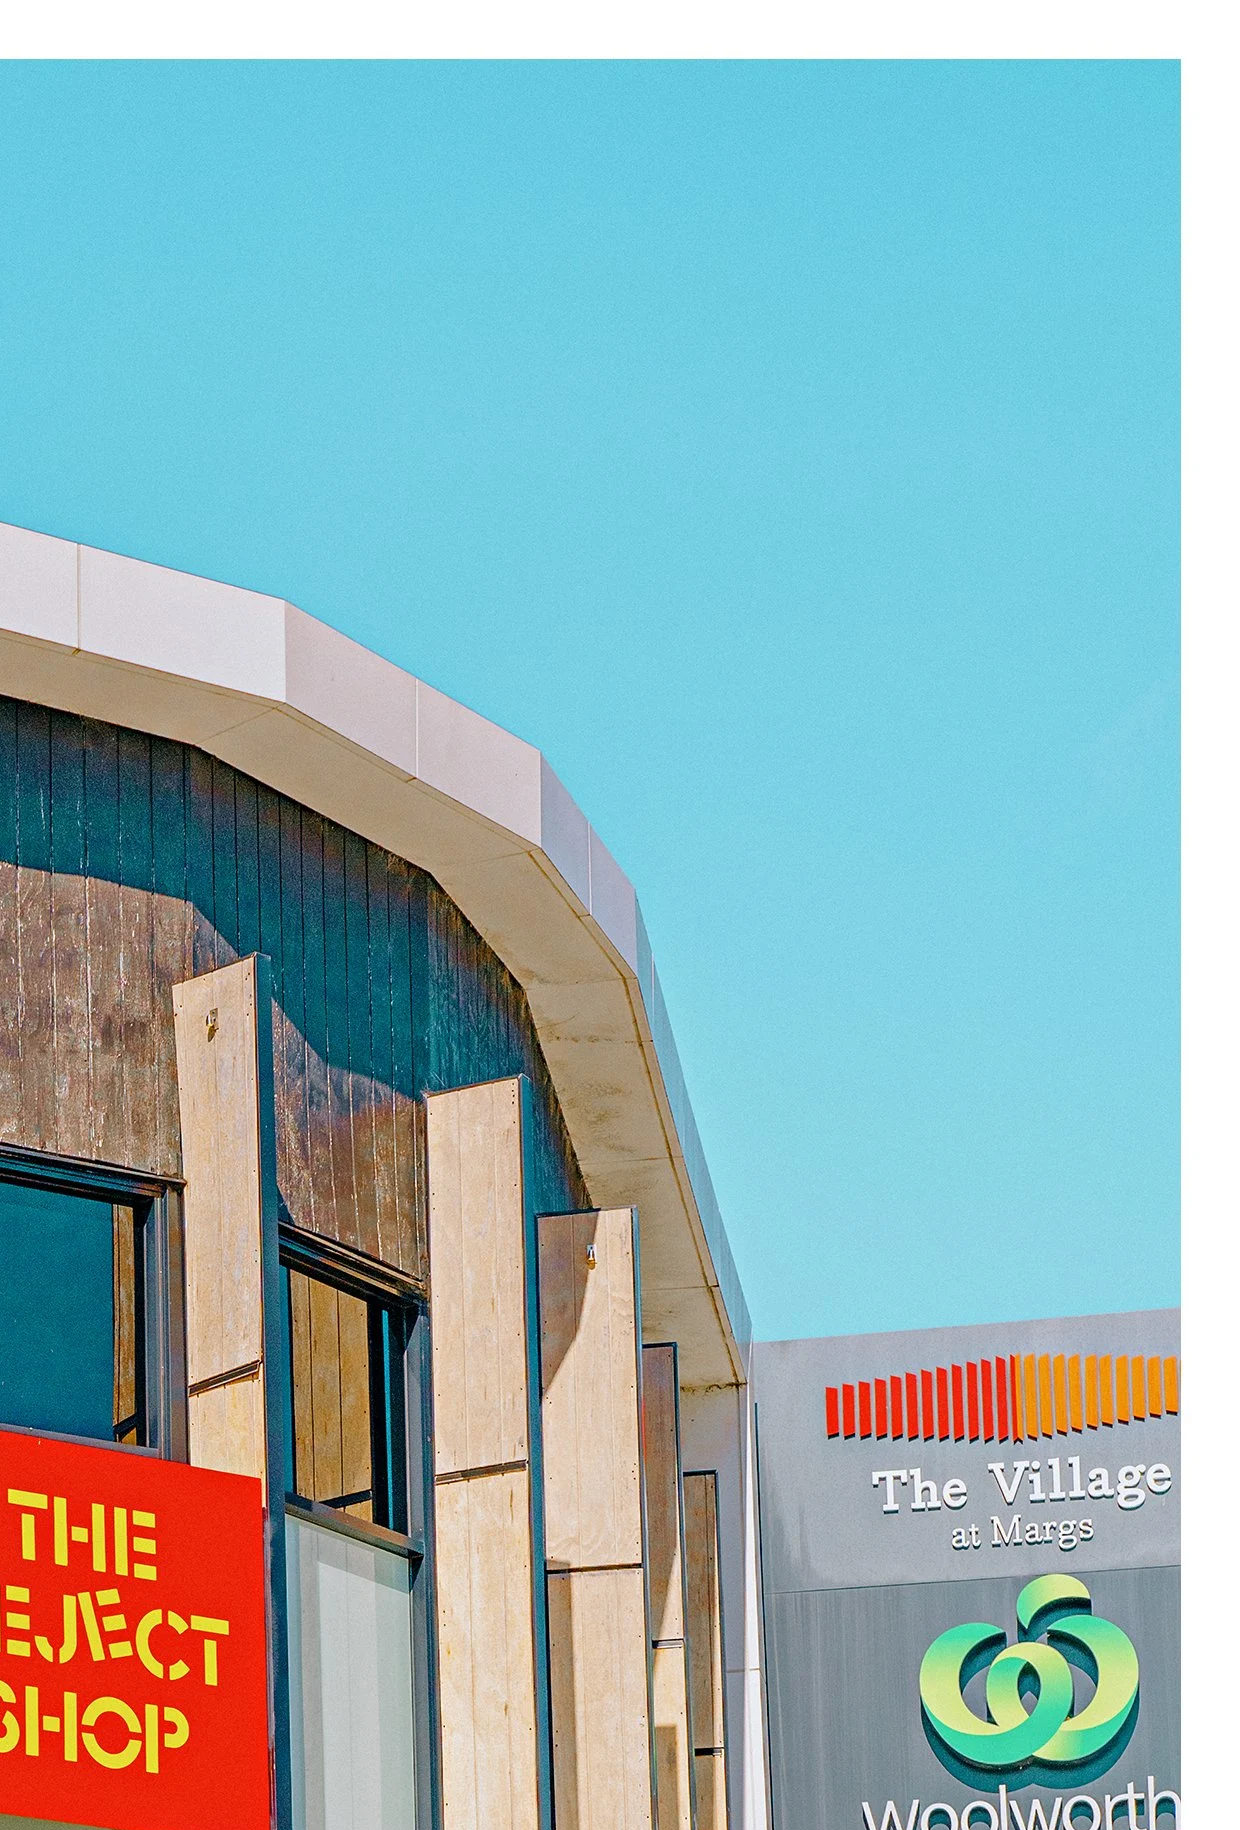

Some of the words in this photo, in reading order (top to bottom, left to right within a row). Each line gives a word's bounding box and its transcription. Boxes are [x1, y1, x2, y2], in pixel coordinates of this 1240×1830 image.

[871, 1467, 968, 1513] The
[987, 1455, 1173, 1511] Village
[7, 1488, 158, 1581] THE
[951, 1523, 982, 1550] at
[990, 1514, 1095, 1551] Margs
